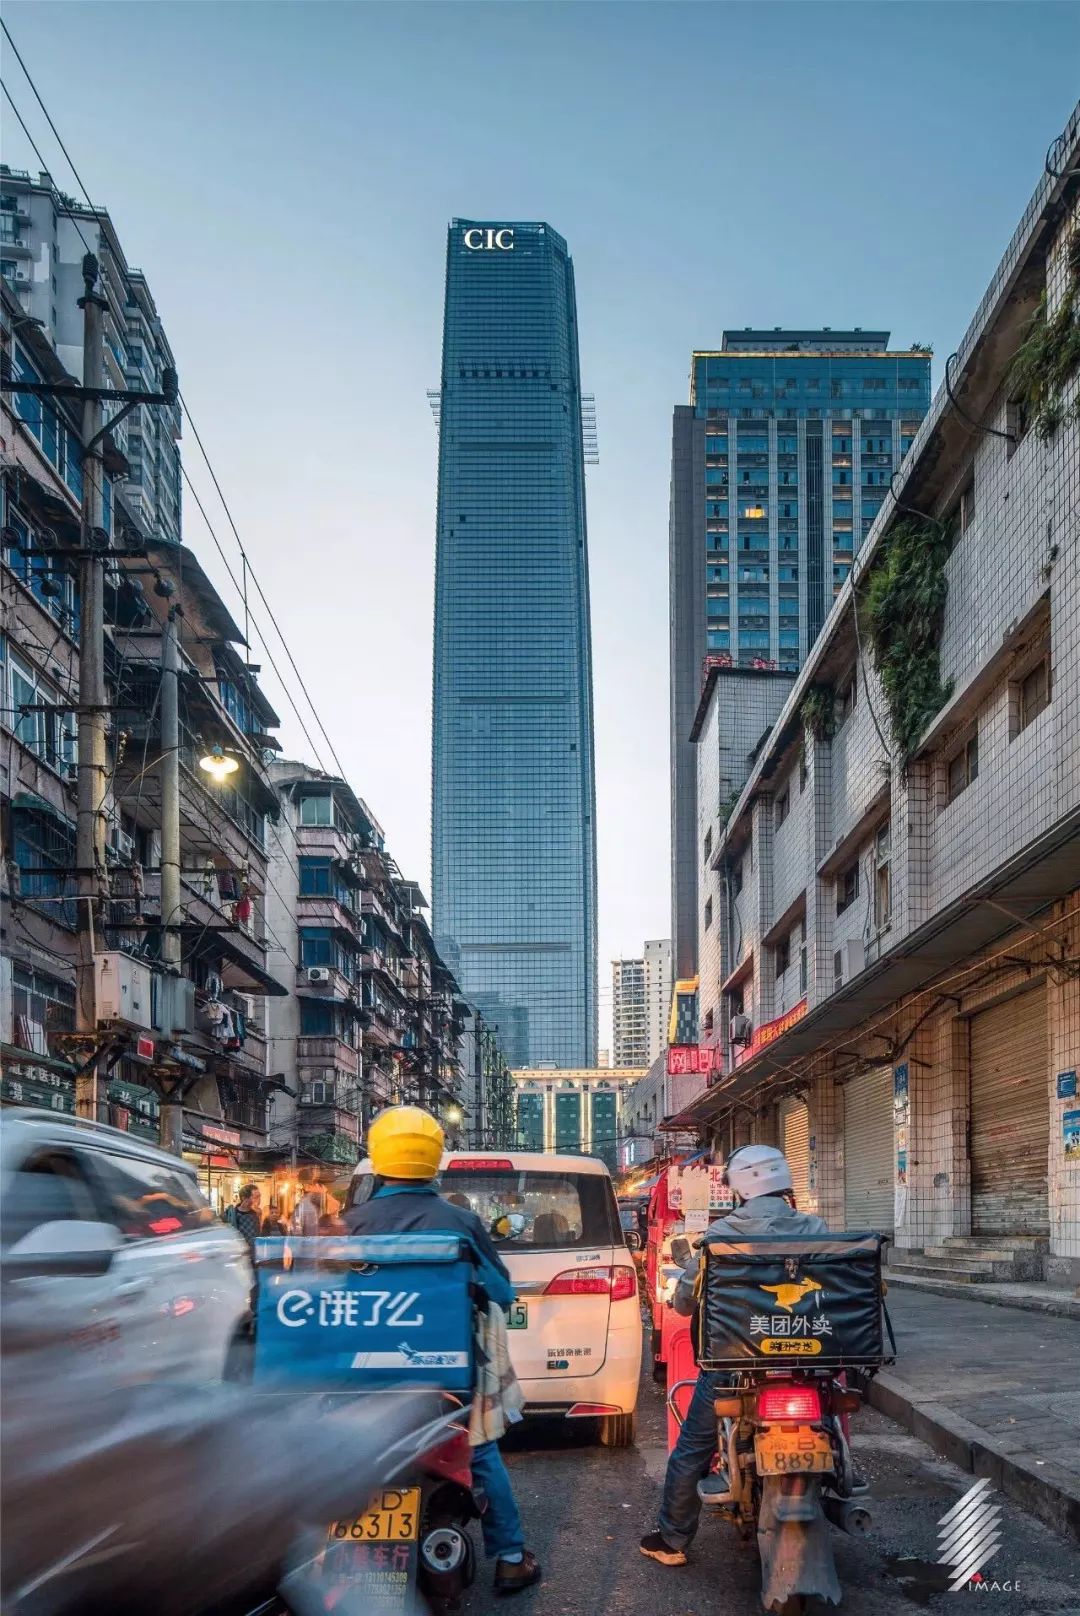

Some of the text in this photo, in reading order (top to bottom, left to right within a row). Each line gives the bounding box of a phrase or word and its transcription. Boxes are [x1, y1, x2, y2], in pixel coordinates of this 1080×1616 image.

[464, 229, 514, 250] CIC
[319, 1290, 424, 1327] 饿了么
[750, 1315, 832, 1336] 美团外卖
